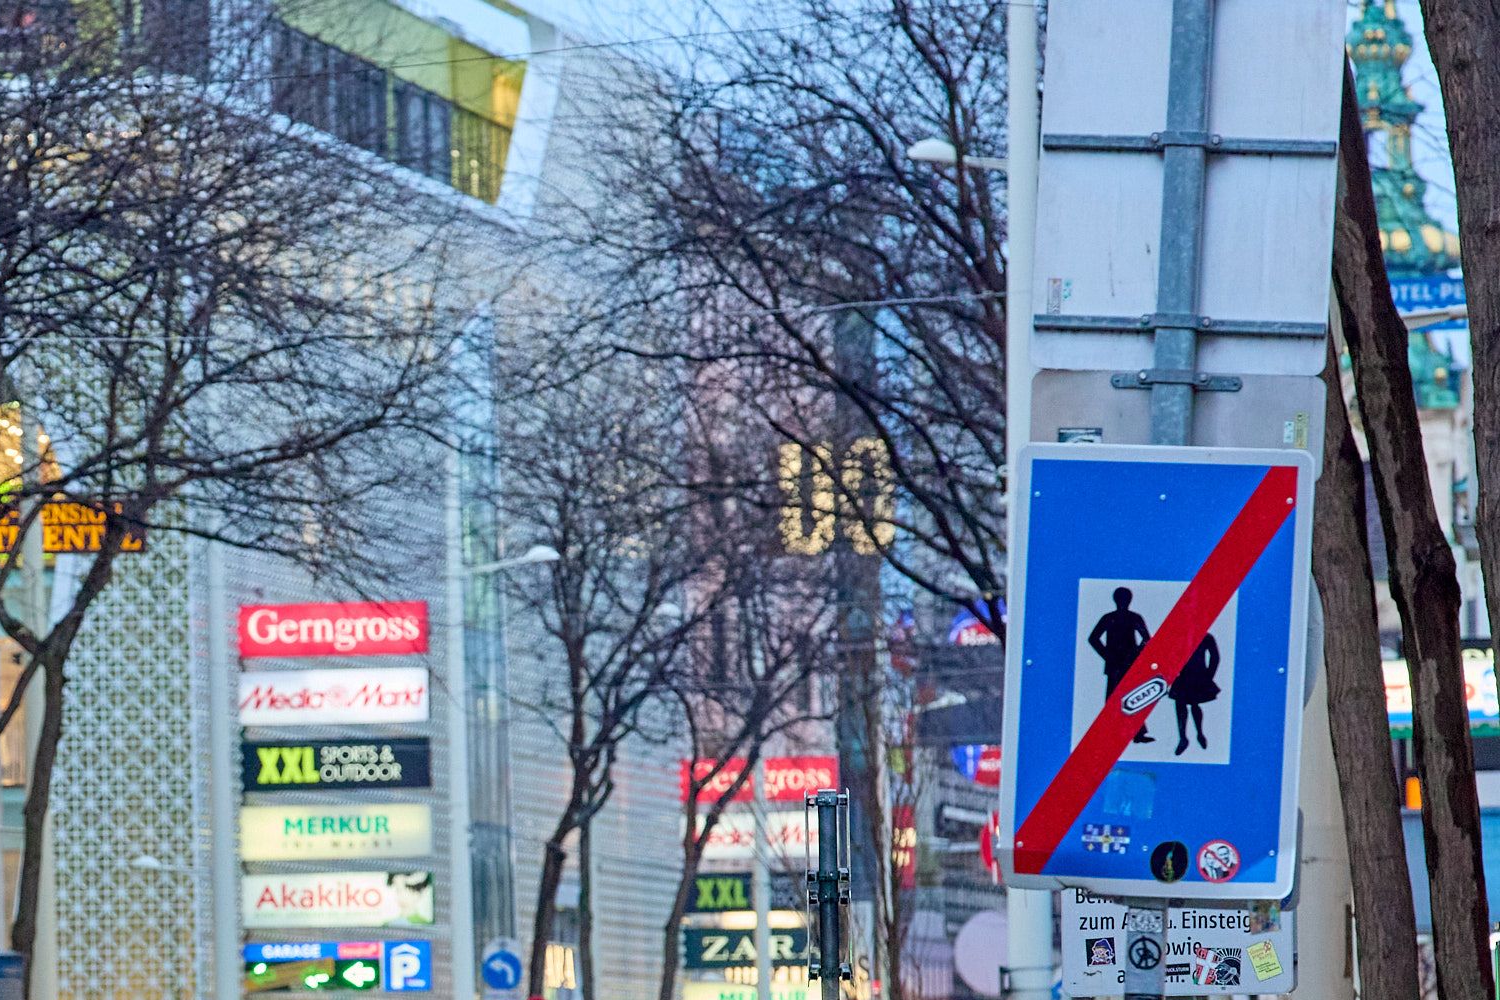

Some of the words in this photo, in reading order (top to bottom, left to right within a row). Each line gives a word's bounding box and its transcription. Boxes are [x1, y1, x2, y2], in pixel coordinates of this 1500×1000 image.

[247, 609, 420, 651] Gerngross
[1129, 685, 1158, 707] KRAFT
[257, 747, 321, 784] XXL
[320, 746, 379, 764] SPORTS
[380, 744, 395, 763] &
[320, 763, 403, 782] OUTDOOR
[284, 815, 390, 834] MERKUR
[256, 882, 382, 910] Akakiko
[696, 877, 748, 908] XXL
[1079, 916, 1115, 931] zum
[1182, 909, 1251, 933] Einsteig
[261, 944, 322, 959] GARAGE
[1165, 937, 1203, 957] owie
